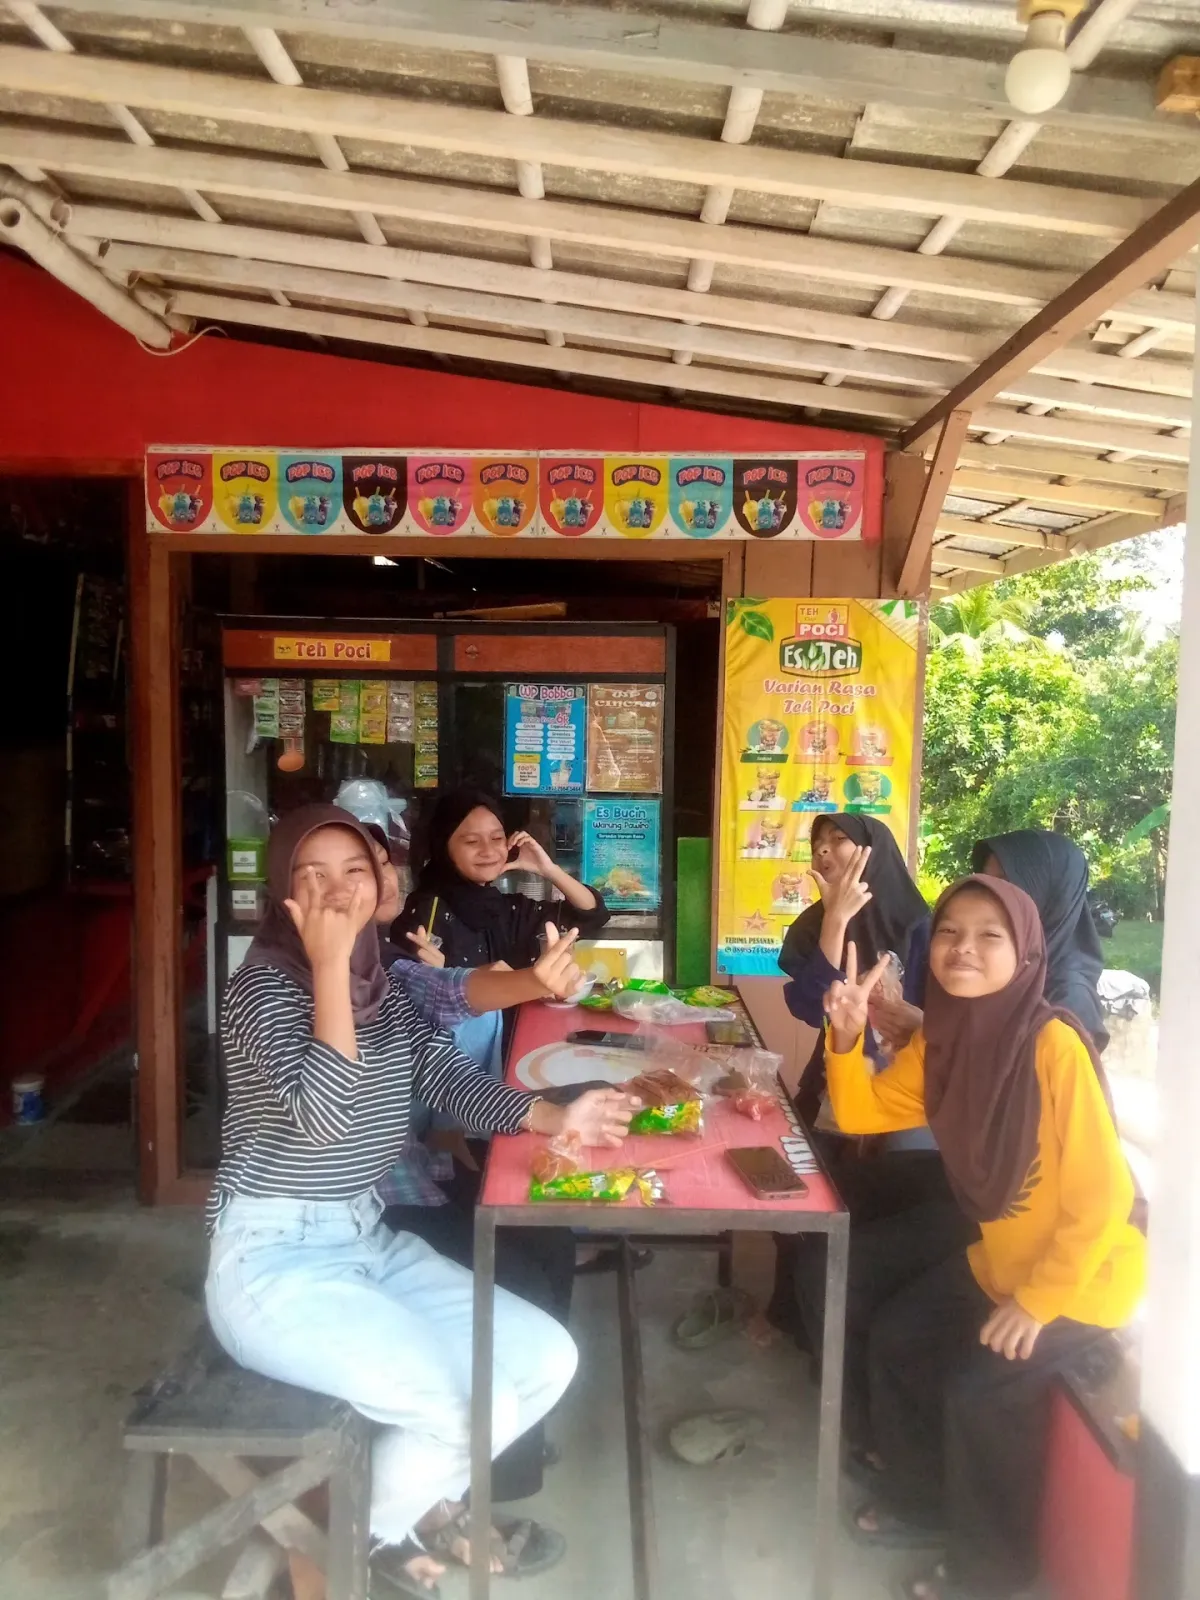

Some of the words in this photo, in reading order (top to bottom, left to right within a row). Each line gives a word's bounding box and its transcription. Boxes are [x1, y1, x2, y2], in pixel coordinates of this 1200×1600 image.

[157, 461, 180, 479] POP
[222, 463, 246, 480] POP
[287, 463, 311, 480] POP
[352, 463, 376, 481] POP
[417, 464, 441, 482] POP
[482, 464, 505, 482] POP
[550, 465, 573, 484] POP
[614, 466, 637, 484] POP
[678, 466, 702, 485] POP
[743, 467, 767, 485] POP
[808, 467, 832, 485] POP
[799, 607, 819, 616] TEH
[799, 623, 845, 637] POCI
[295, 641, 327, 657] Teh
[334, 642, 371, 659] Poci
[784, 644, 804, 669] Es
[815, 641, 857, 671] Teh
[519, 685, 538, 698] WP
[540, 685, 574, 700] Bobba
[763, 679, 824, 695] Varian
[828, 680, 876, 696] Rasa
[784, 700, 812, 714] Teh
[818, 700, 854, 715] Poci
[596, 806, 610, 818] Es
[613, 806, 646, 819] Bucin
[592, 821, 622, 831] Warung
